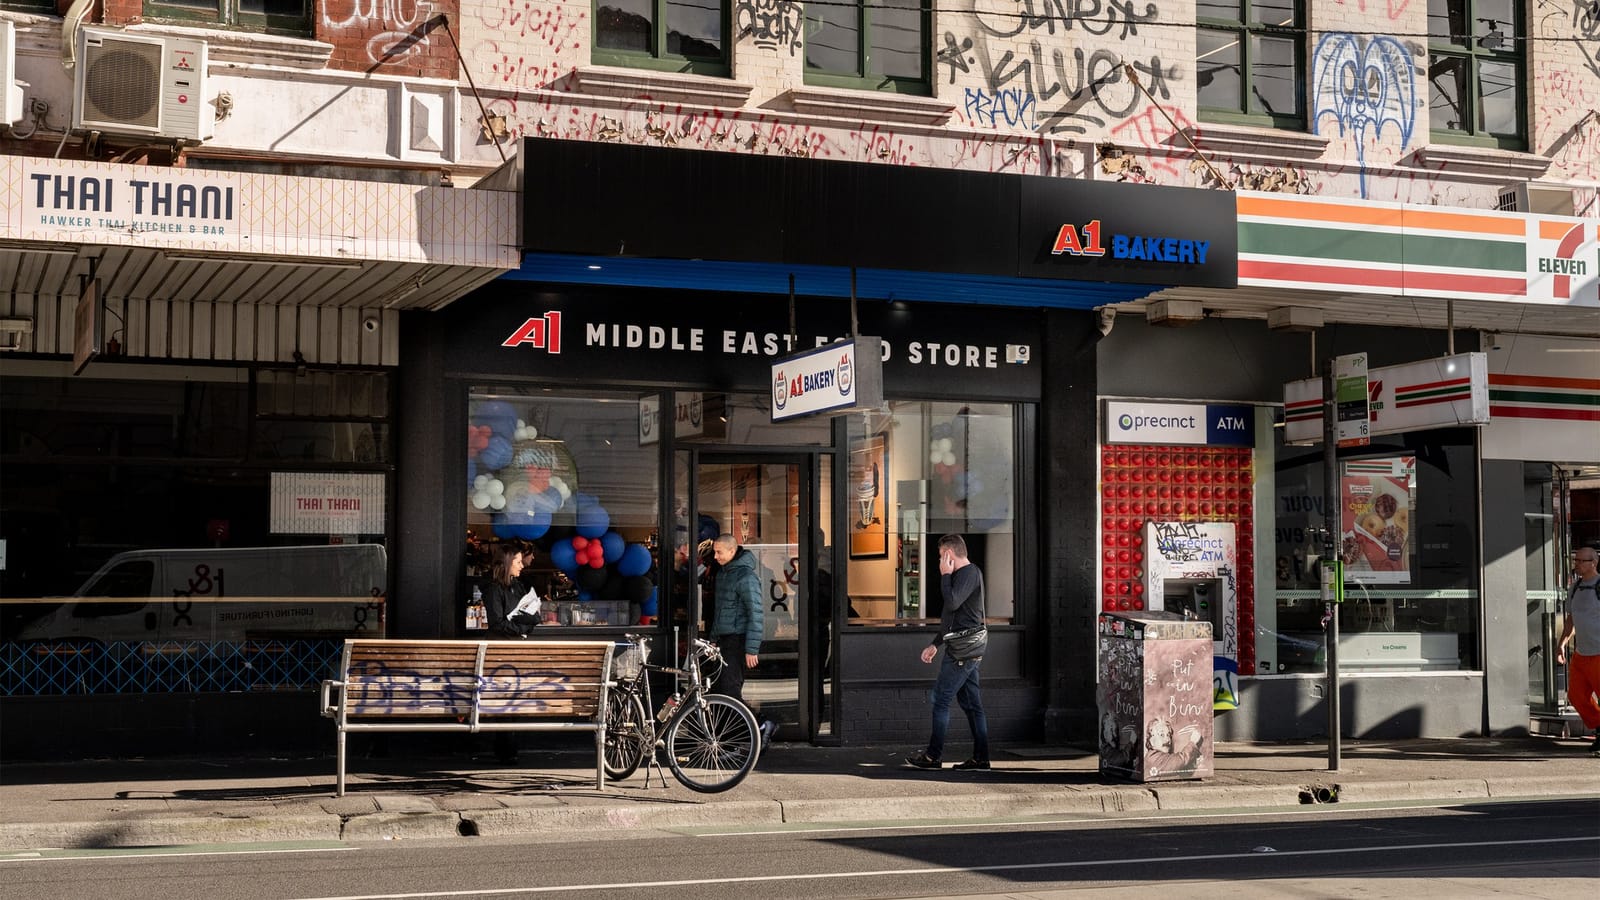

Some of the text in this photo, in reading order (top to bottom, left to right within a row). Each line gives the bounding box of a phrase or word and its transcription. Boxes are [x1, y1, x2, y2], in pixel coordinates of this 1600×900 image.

[31, 173, 233, 220] THAI THANI
[40, 214, 92, 227] HAWKER
[98, 218, 126, 229] THAI
[131, 221, 183, 233] KITCHEN
[202, 225, 225, 236] BAR
[1051, 219, 1211, 265] A1 BAKERY
[501, 310, 562, 354] A1
[586, 322, 704, 352] MIDDLE
[722, 330, 798, 356] EAST
[908, 341, 998, 368] STORE
[789, 369, 835, 398] A1 BAKERY
[1134, 415, 1246, 431] precinct ATM
[1359, 425, 1369, 436] 16
[296, 497, 361, 511] THAI THANI
[1200, 550, 1225, 561] ATM
[1171, 658, 1195, 678] Put
[1175, 678, 1195, 692] in
[1168, 695, 1201, 719] Bin
